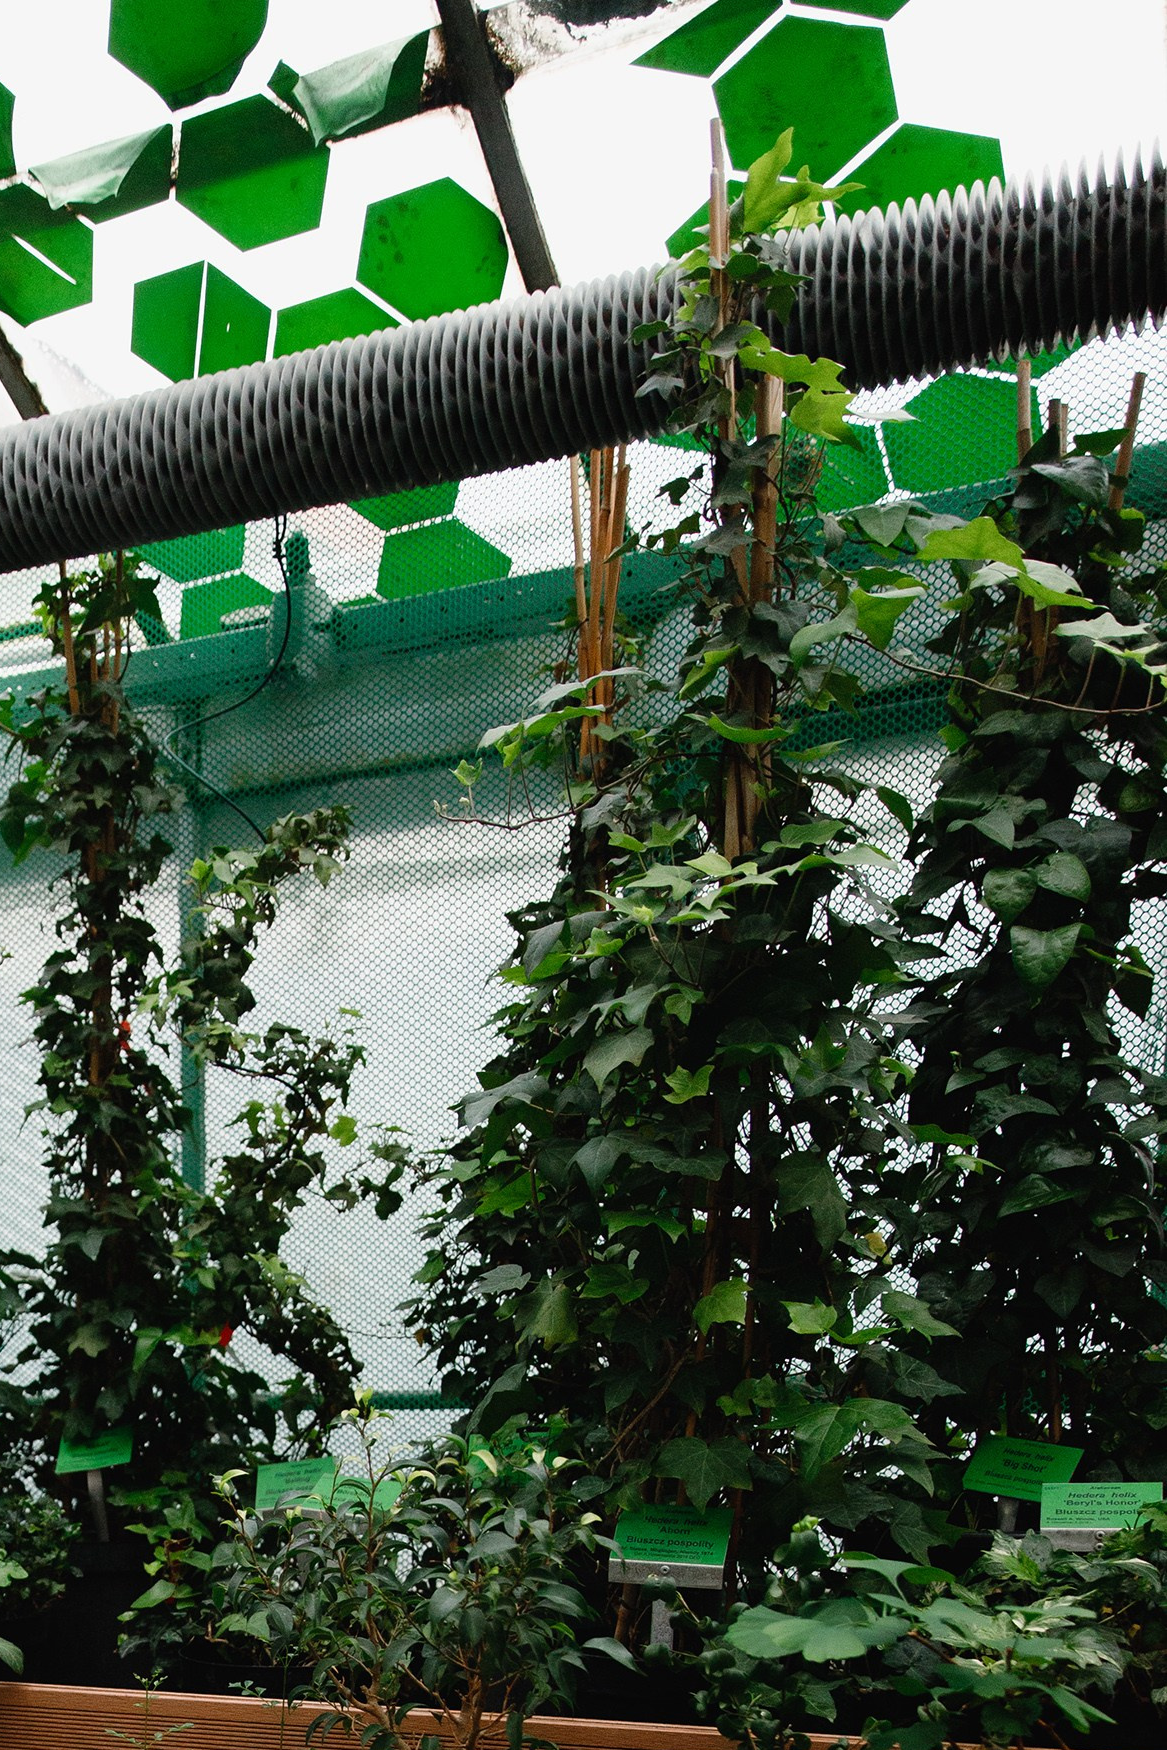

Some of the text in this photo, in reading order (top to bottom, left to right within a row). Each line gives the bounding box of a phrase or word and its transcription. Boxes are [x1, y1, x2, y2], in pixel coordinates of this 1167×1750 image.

[1003, 1447, 1055, 1462] Hedera helix
[1067, 1491, 1138, 1499] Hedera helix
[626, 1535, 715, 1550] Bluszcz pospolity
